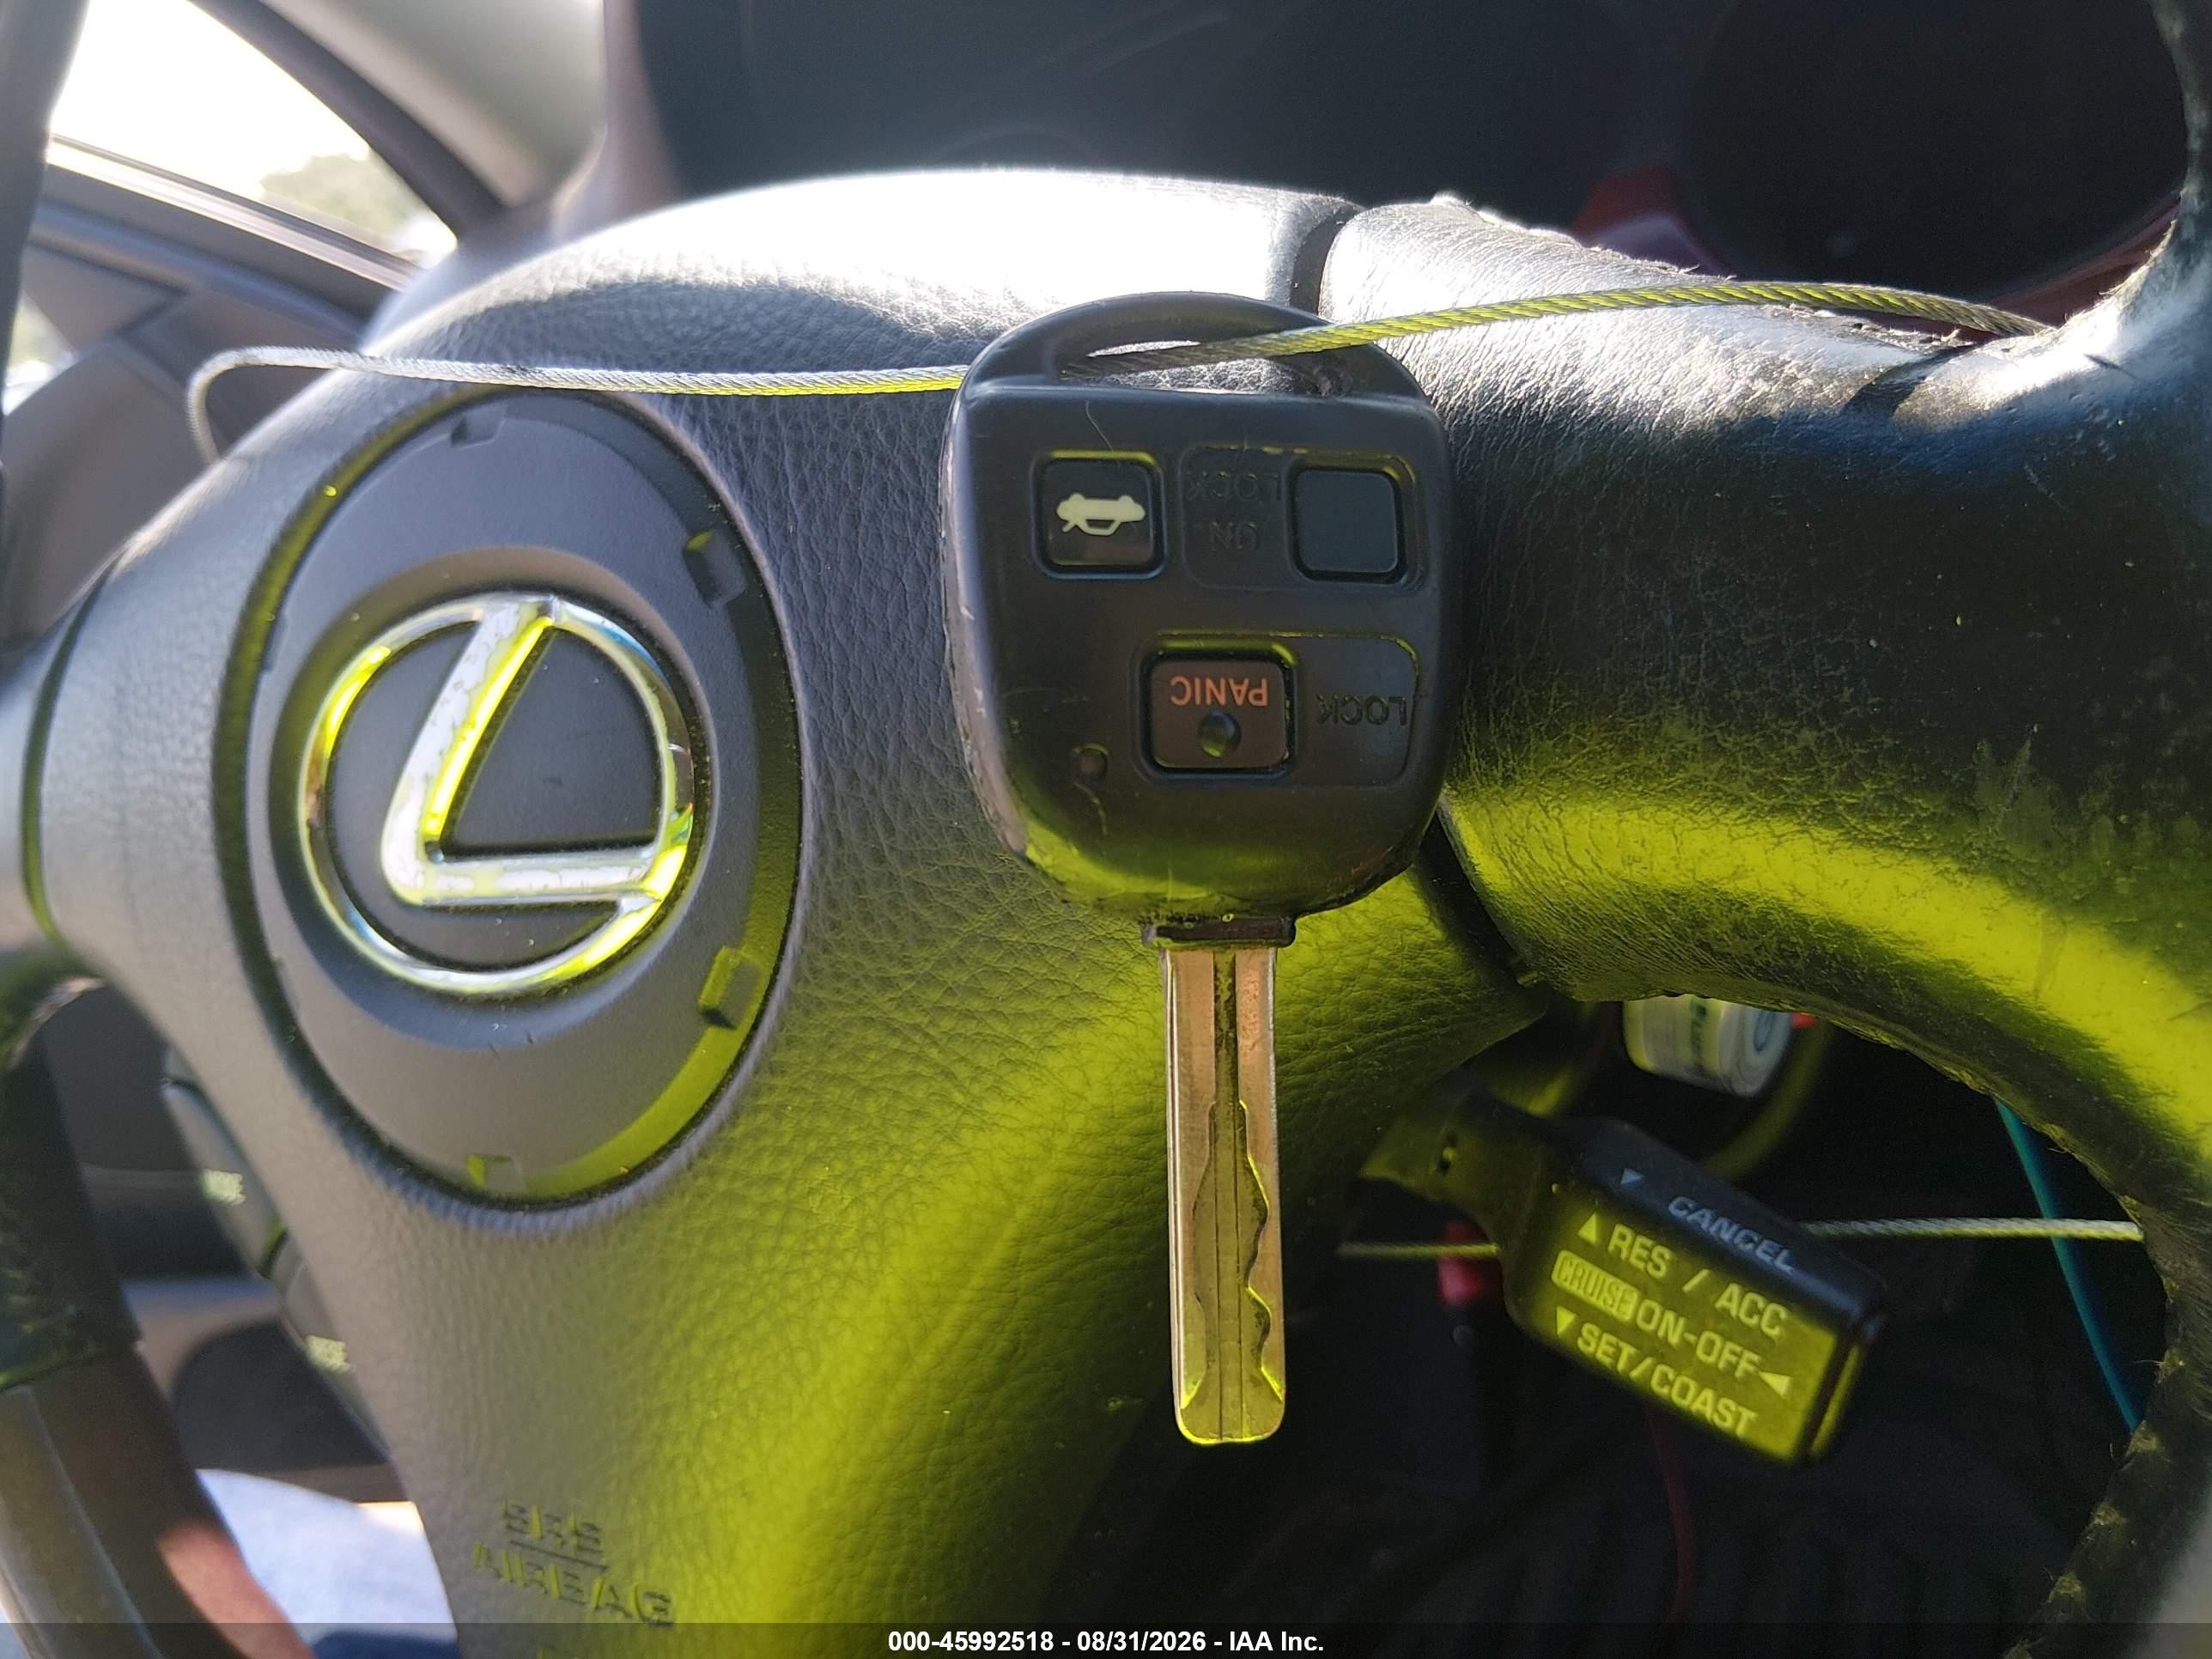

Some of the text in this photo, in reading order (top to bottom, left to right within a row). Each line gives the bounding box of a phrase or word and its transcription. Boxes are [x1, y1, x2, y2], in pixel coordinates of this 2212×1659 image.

[1170, 675, 1269, 708] PANIC
[1316, 694, 1408, 727] LOCK
[1607, 1223, 1674, 1279] RES
[1714, 1282, 1789, 1344] ACC
[1668, 1196, 1796, 1274] CANCEL
[1552, 1249, 1761, 1379] CRUISE ON-OFF
[1577, 1322, 1759, 1439] SET/COAST
